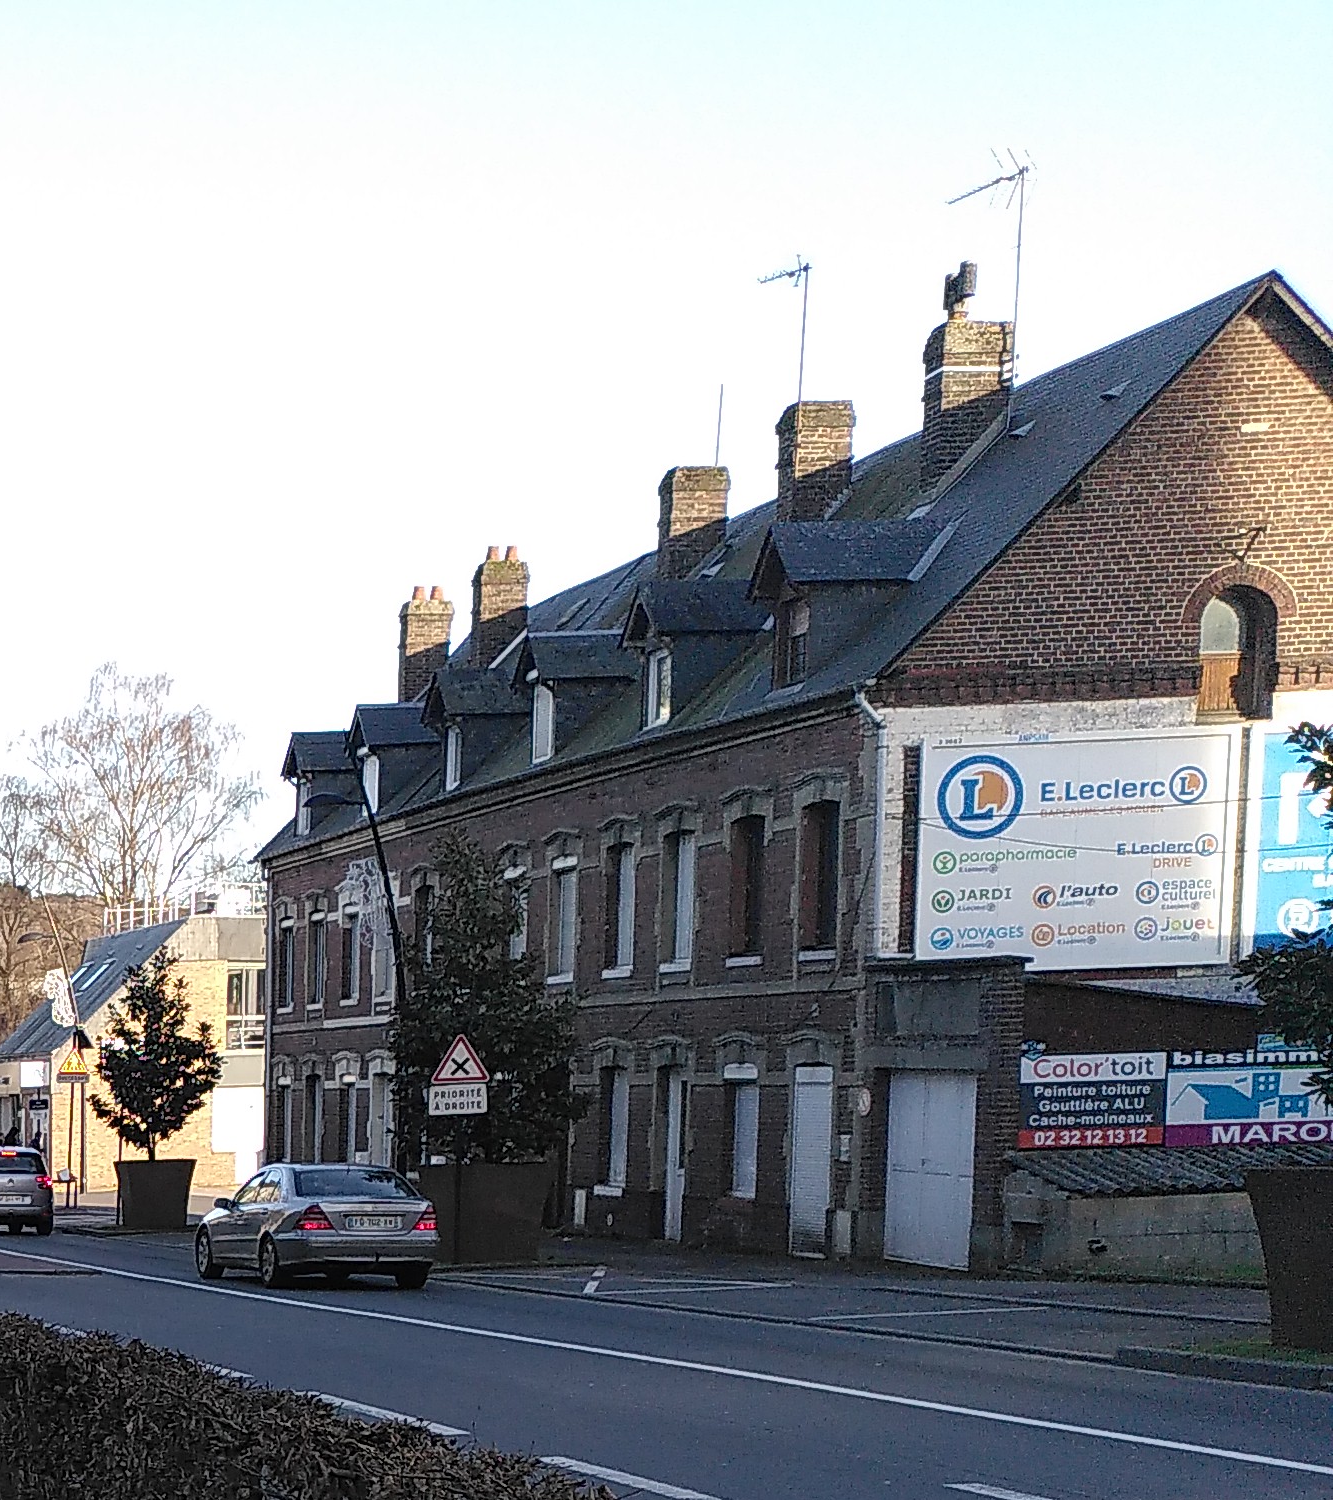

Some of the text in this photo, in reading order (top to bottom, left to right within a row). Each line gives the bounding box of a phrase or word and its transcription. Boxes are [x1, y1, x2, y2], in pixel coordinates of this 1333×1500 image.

[1040, 779, 1165, 803] E.Leclerc
[1116, 841, 1194, 856] E.Leclerc
[959, 848, 1078, 865] parapharmacie
[1153, 856, 1192, 869] DRIVE
[1059, 882, 1119, 899] l'auto
[1162, 878, 1213, 894] espace
[957, 887, 1013, 902] JARDI
[1161, 888, 1216, 902] culturel
[1057, 921, 1126, 937] Location
[1160, 916, 1216, 932] jouet
[957, 925, 1025, 940] VOYAGES
[1033, 1056, 1156, 1079] Color'toit
[433, 1087, 483, 1101] PRIORITÉ
[1034, 1083, 1152, 1098] Peinture toiture
[444, 1100, 483, 1110] DROITE
[1038, 1097, 1146, 1113] Gouttière ALU
[1029, 1112, 1155, 1127] Cache-moineaux
[1034, 1128, 1148, 1146] 02 32 12 13 12
